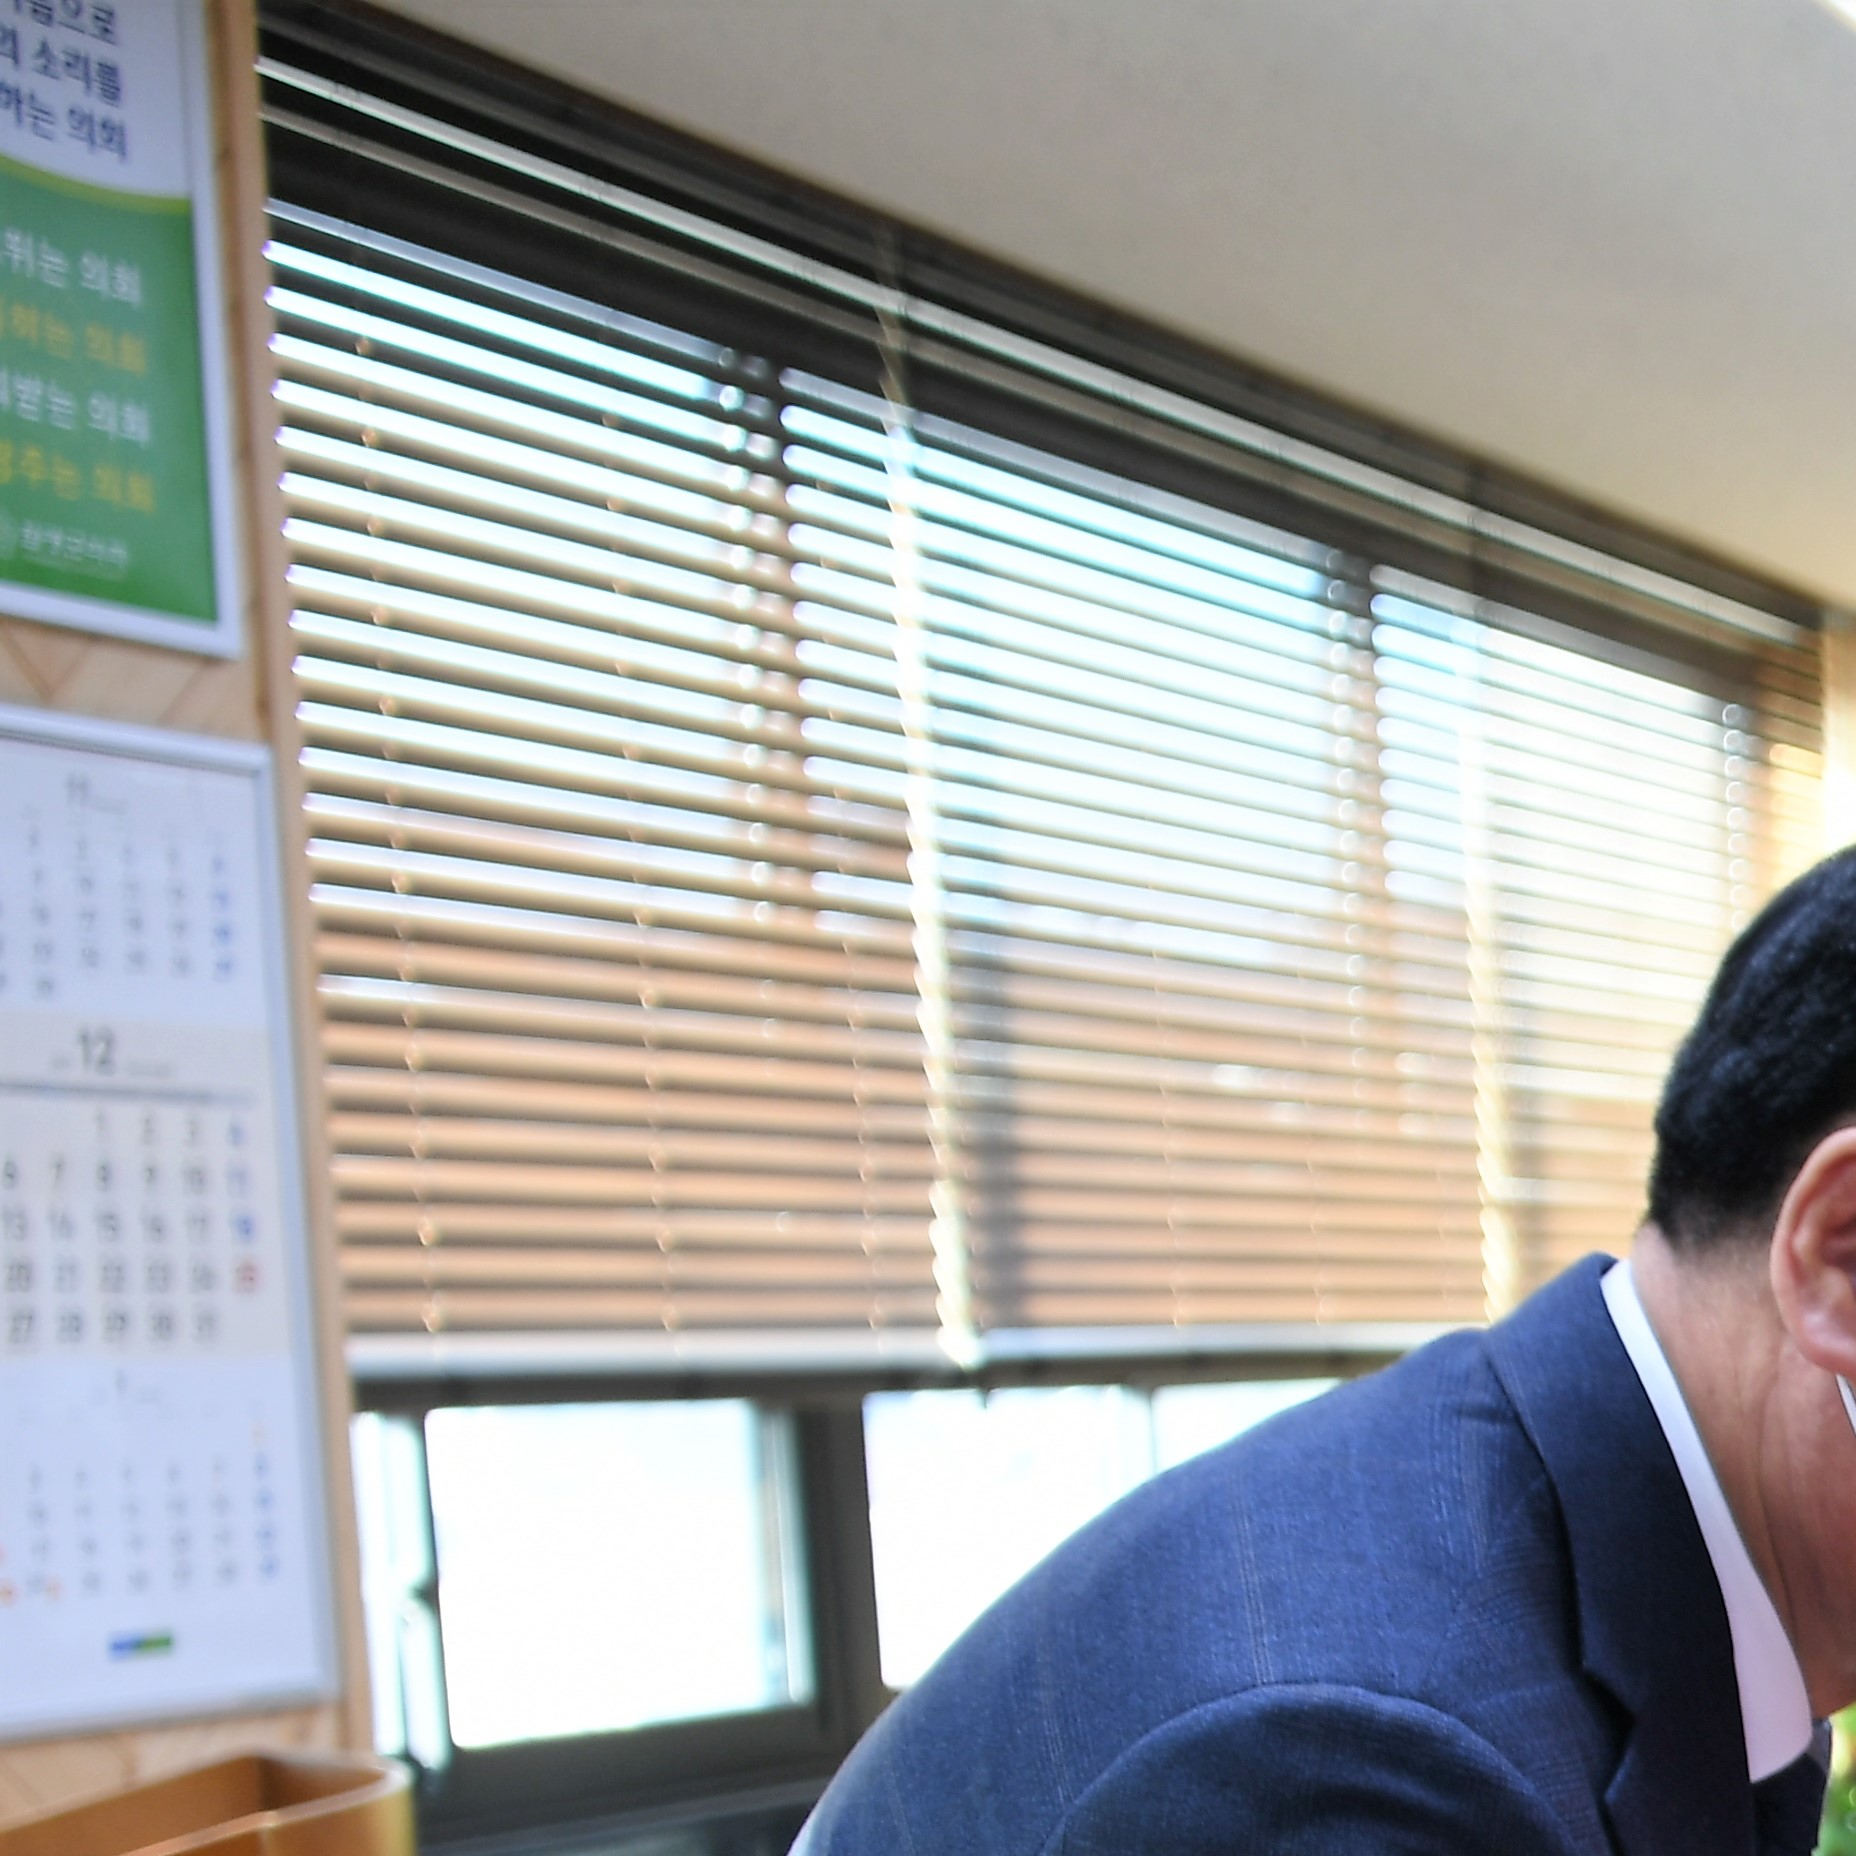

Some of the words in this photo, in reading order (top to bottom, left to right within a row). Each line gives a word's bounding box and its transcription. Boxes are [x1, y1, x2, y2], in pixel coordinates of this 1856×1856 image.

[31, 38, 122, 108] 소리를
[66, 104, 129, 164] 의회
[78, 250, 143, 308] 의회
[85, 322, 148, 378] 의회
[0, 367, 78, 432] 받는
[87, 391, 152, 448] 의회
[78, 1027, 116, 1075] 12
